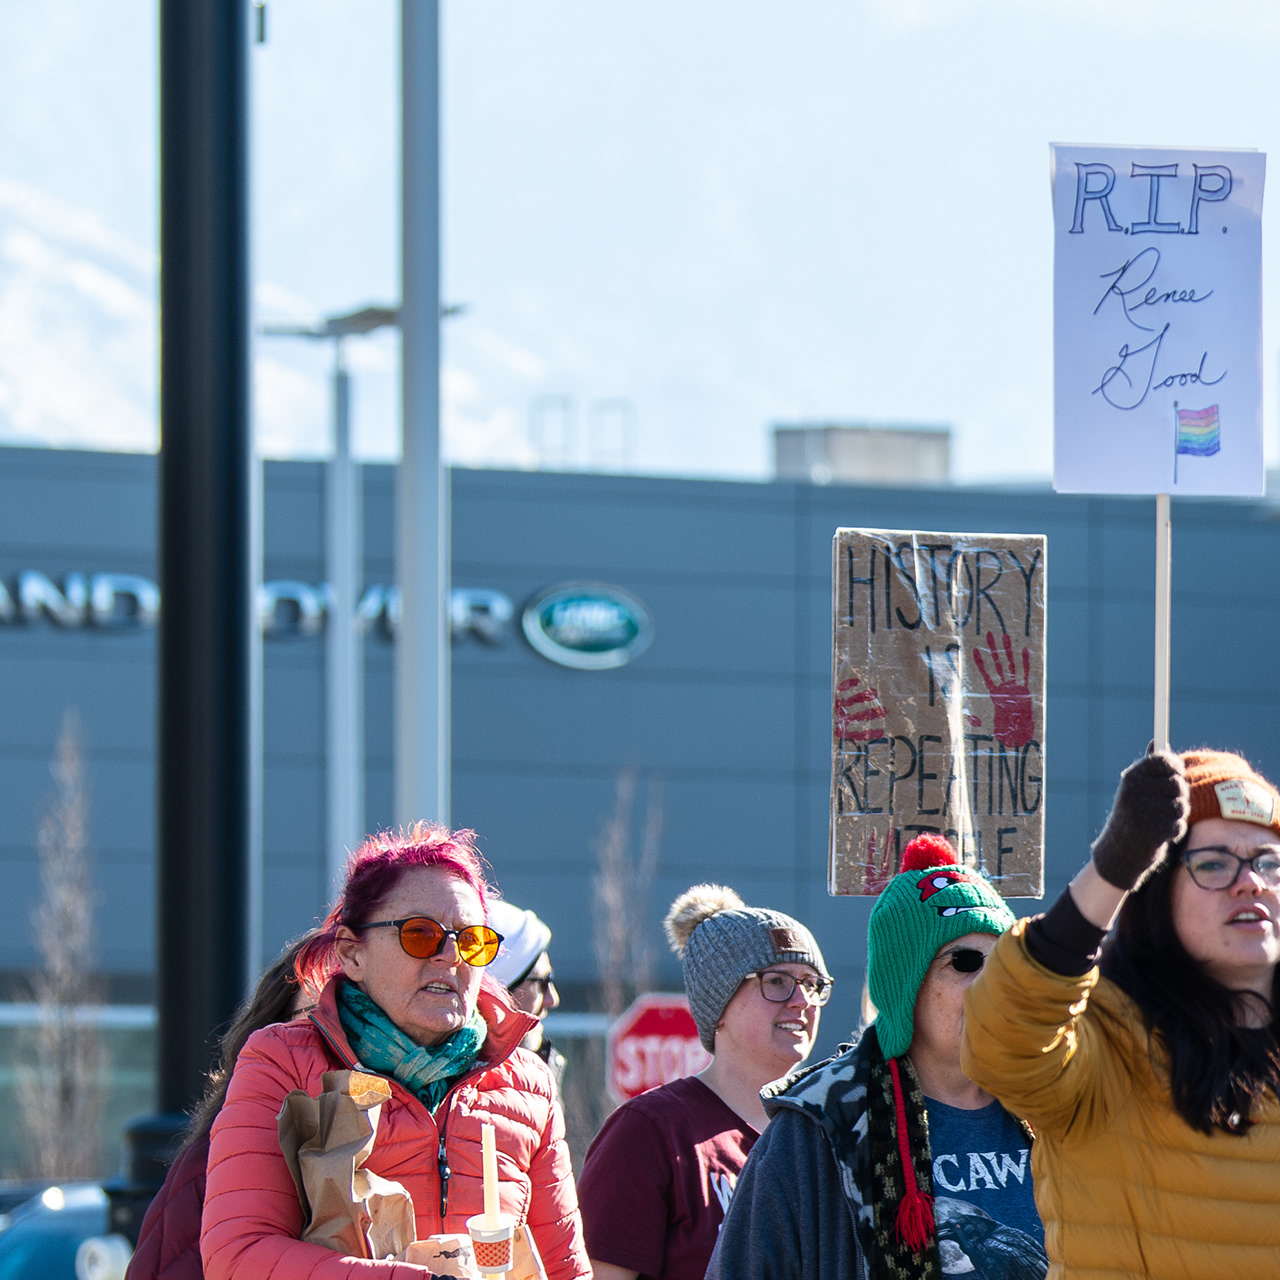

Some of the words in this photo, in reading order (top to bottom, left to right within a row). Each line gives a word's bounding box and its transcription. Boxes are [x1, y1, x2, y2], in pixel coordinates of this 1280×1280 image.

[1069, 161, 1233, 235] R.I.P.
[1094, 246, 1214, 332] Renee
[1092, 322, 1228, 411] Good
[847, 541, 1042, 639] HISTORY
[616, 1035, 711, 1089] STOP
[932, 1148, 1030, 1193] CAW
